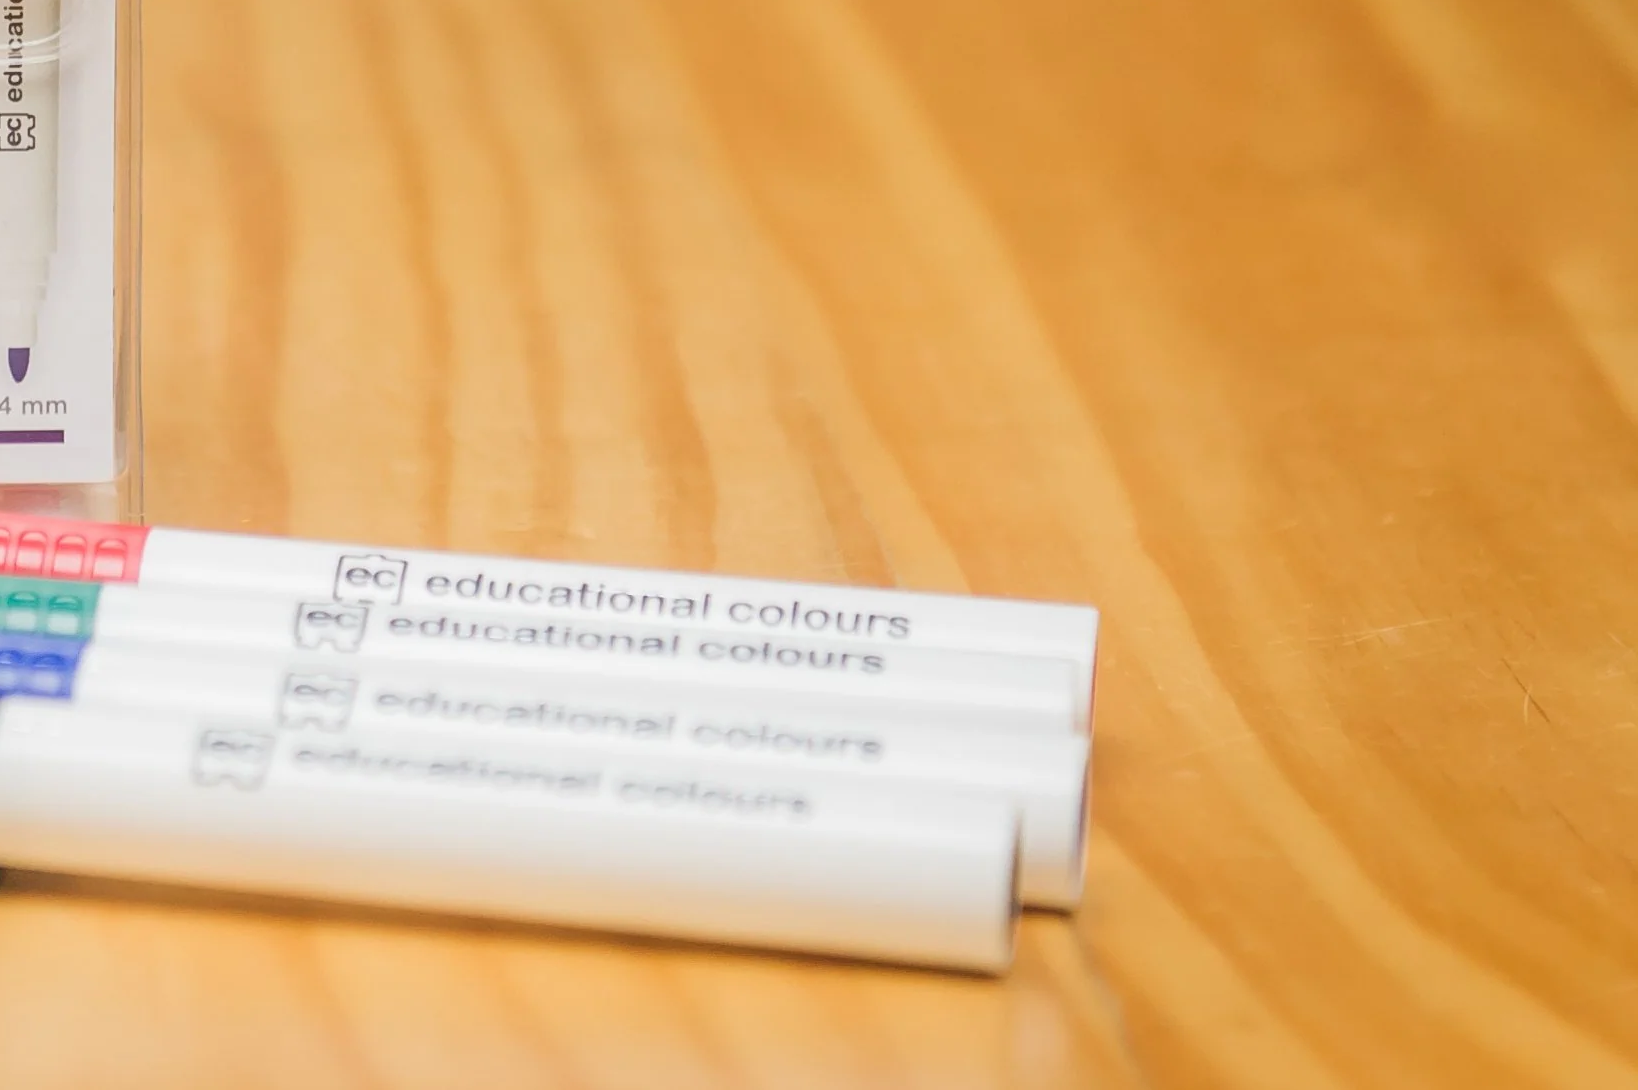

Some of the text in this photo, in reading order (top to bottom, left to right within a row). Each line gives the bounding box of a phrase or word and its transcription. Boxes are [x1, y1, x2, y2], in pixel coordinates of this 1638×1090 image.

[21, 398, 68, 416] mm
[424, 571, 713, 620] educational
[727, 599, 913, 640] colours
[387, 613, 681, 657] educational
[697, 640, 886, 674] colours
